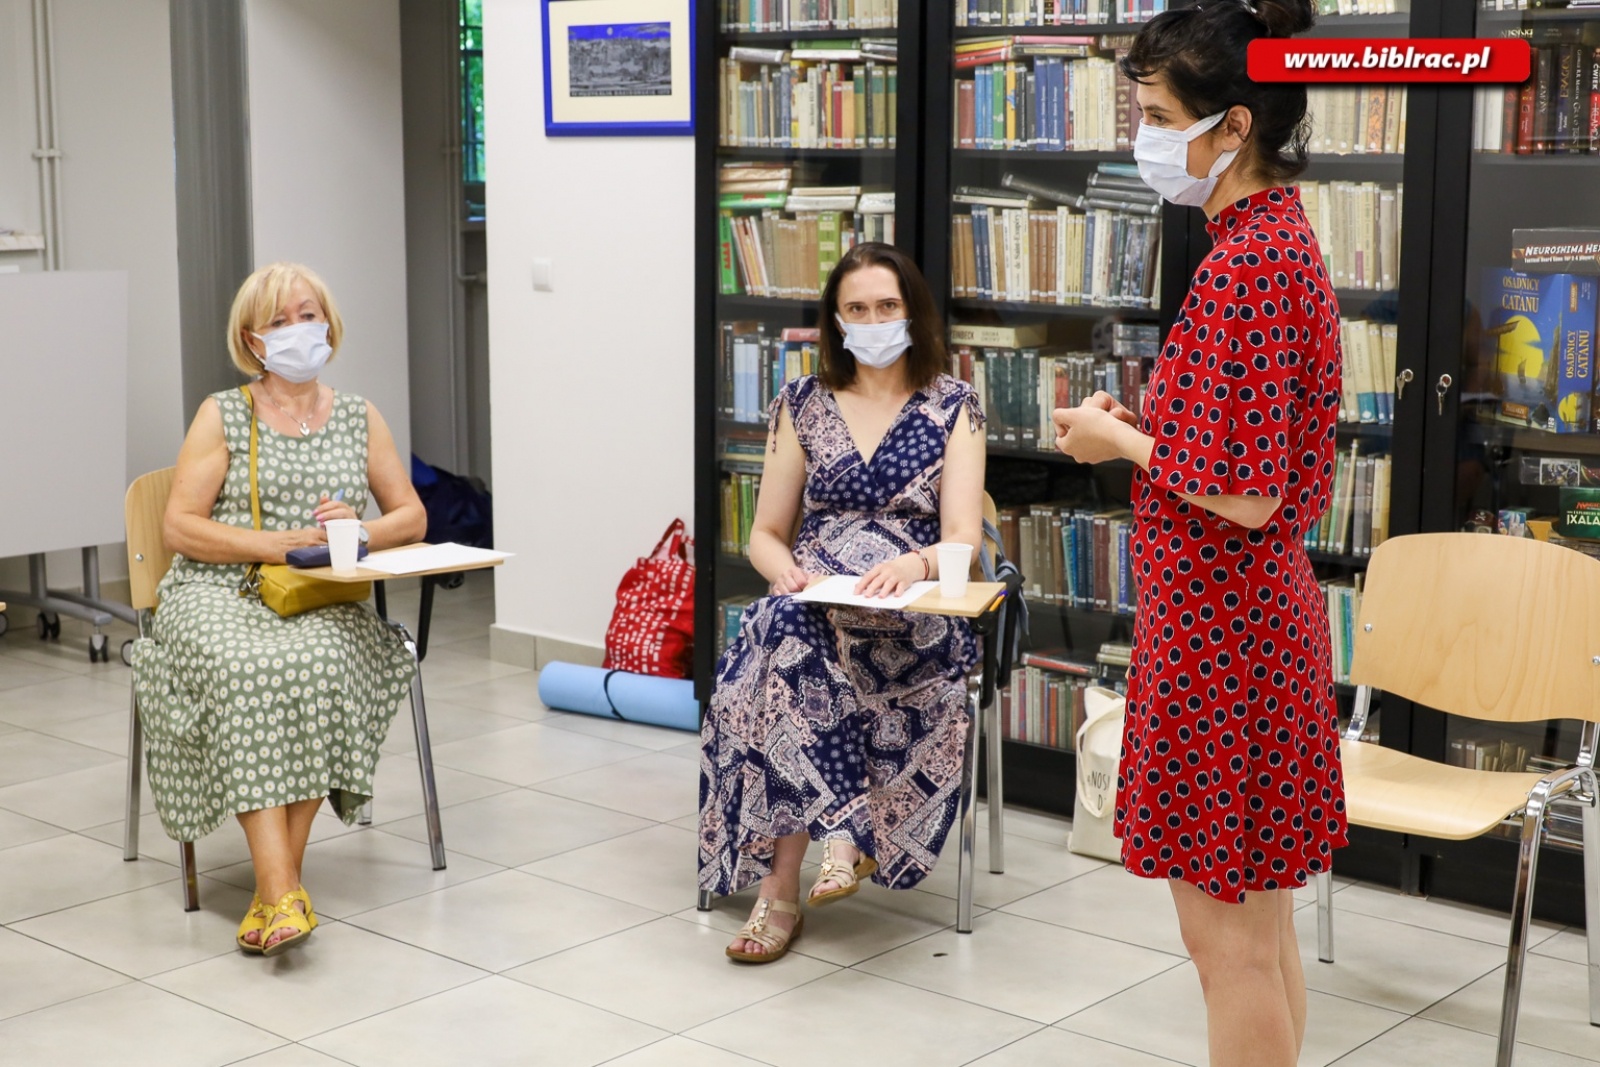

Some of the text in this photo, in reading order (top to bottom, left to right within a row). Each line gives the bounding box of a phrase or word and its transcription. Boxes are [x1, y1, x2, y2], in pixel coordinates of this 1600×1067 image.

[1560, 55, 1570, 98] ERAGON
[1525, 245, 1583, 256] NEUROSHIMA
[1502, 276, 1540, 291] OSADNICY
[1502, 294, 1540, 313] CATANU
[1565, 330, 1576, 379] OSADNICY
[1577, 330, 1590, 378] CATANU
